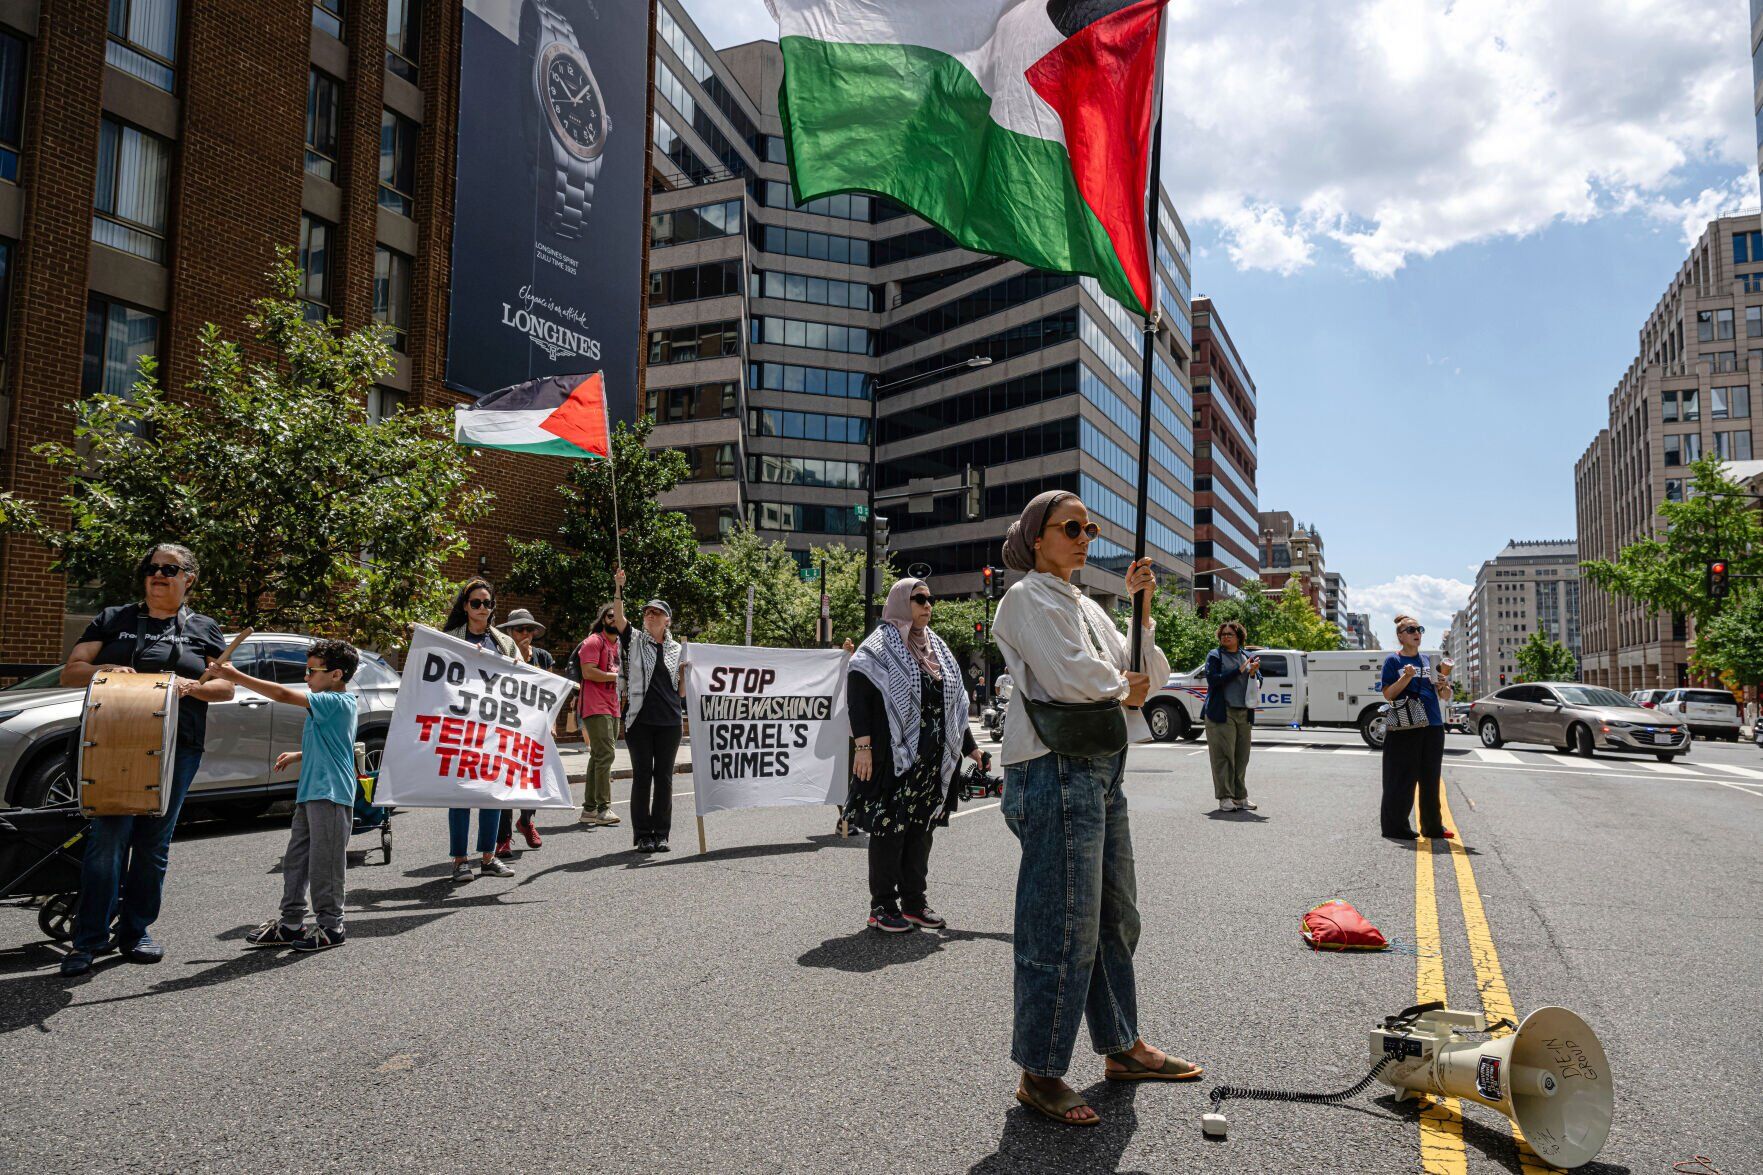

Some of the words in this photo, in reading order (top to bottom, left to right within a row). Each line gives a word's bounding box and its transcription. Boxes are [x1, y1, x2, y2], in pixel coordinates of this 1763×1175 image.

[551, 71, 560, 82] 10
[567, 64, 574, 76] 12
[550, 86, 557, 96] 9
[586, 92, 592, 101] 2
[555, 104, 561, 114] 8
[589, 109, 595, 118] 3
[563, 119, 569, 129] 7
[535, 241, 563, 260] LONGINES
[562, 255, 579, 268] SPIRIT
[536, 250, 552, 263] ZULU
[551, 257, 565, 270] TIME
[518, 284, 548, 312] Elegance
[547, 298, 555, 311] is
[554, 306, 563, 318] an
[562, 306, 589, 330] attitude
[501, 302, 601, 361] LONGINES
[422, 652, 466, 687] DO
[478, 668, 557, 713] YOUR
[709, 666, 776, 694] STOP
[449, 690, 522, 729] JOB
[701, 695, 829, 721] WHITEWASHING
[1261, 693, 1292, 704] ICE
[495, 726, 545, 768] THE
[709, 723, 809, 752] ISRAEL'S
[435, 746, 542, 790] TRUTH
[710, 751, 790, 781] CRIMES
[1543, 1038, 1582, 1080] DIE-IN
[1565, 1040, 1598, 1081] GROUP
